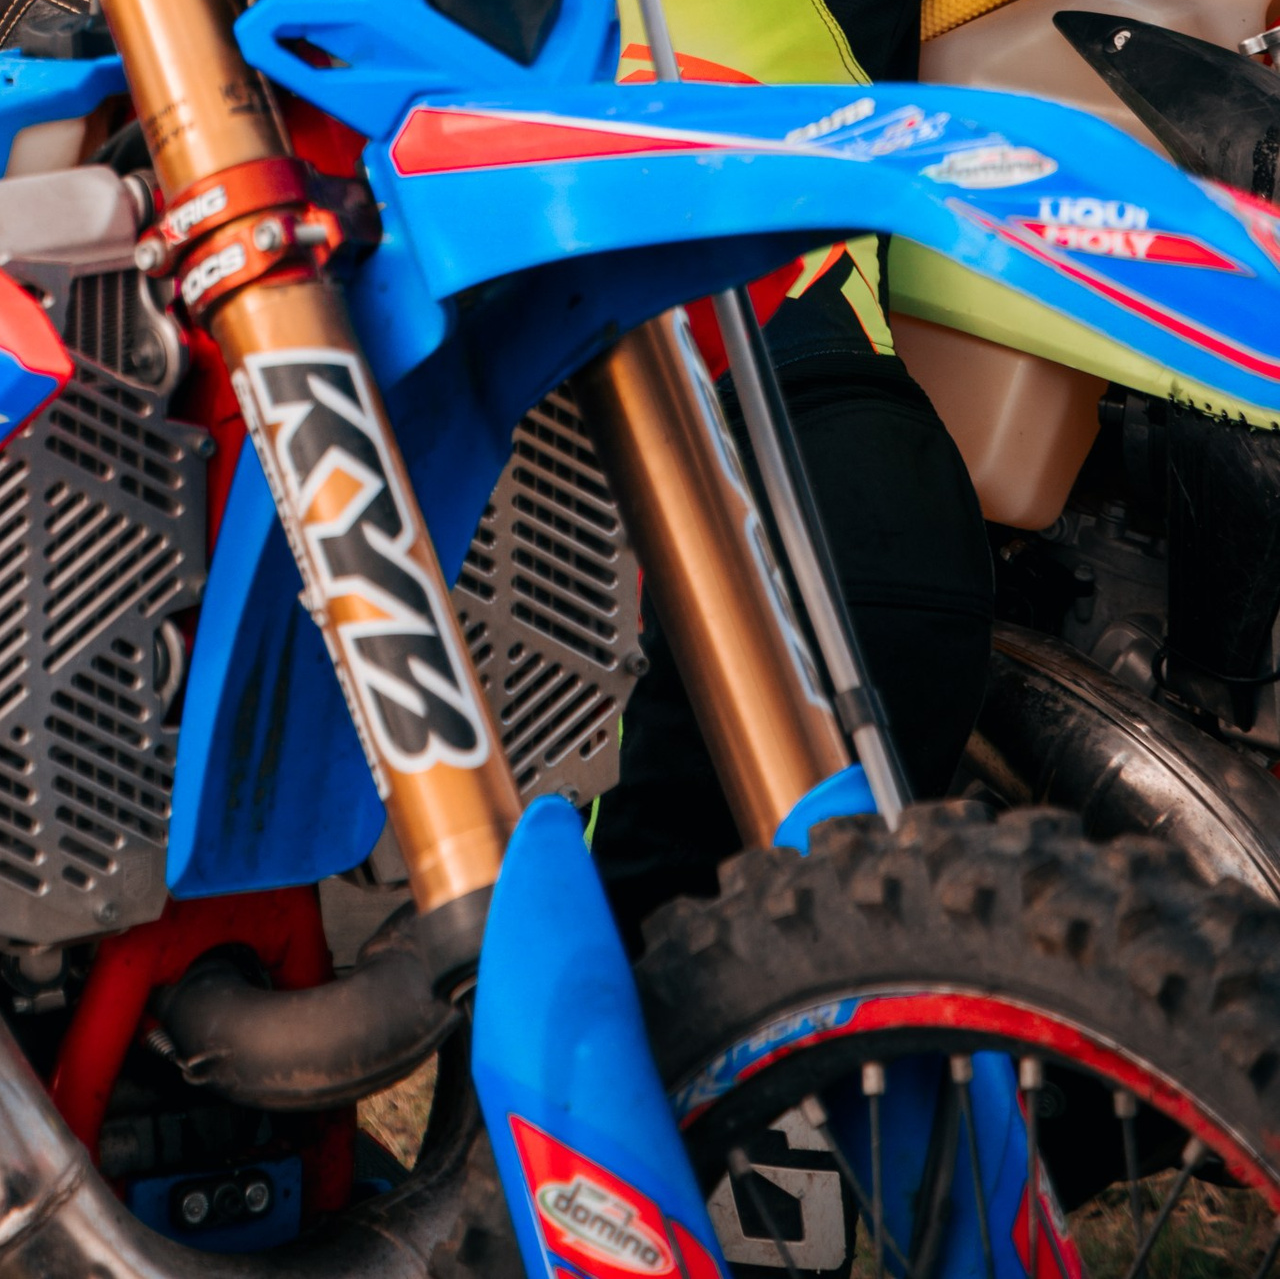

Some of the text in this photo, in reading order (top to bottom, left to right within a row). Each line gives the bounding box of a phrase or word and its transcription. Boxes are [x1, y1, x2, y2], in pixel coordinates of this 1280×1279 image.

[1038, 197, 1150, 230] LIQUI
[1043, 224, 1156, 259] MOLY
[244, 350, 491, 774] KYB
[553, 1183, 661, 1268] domino
